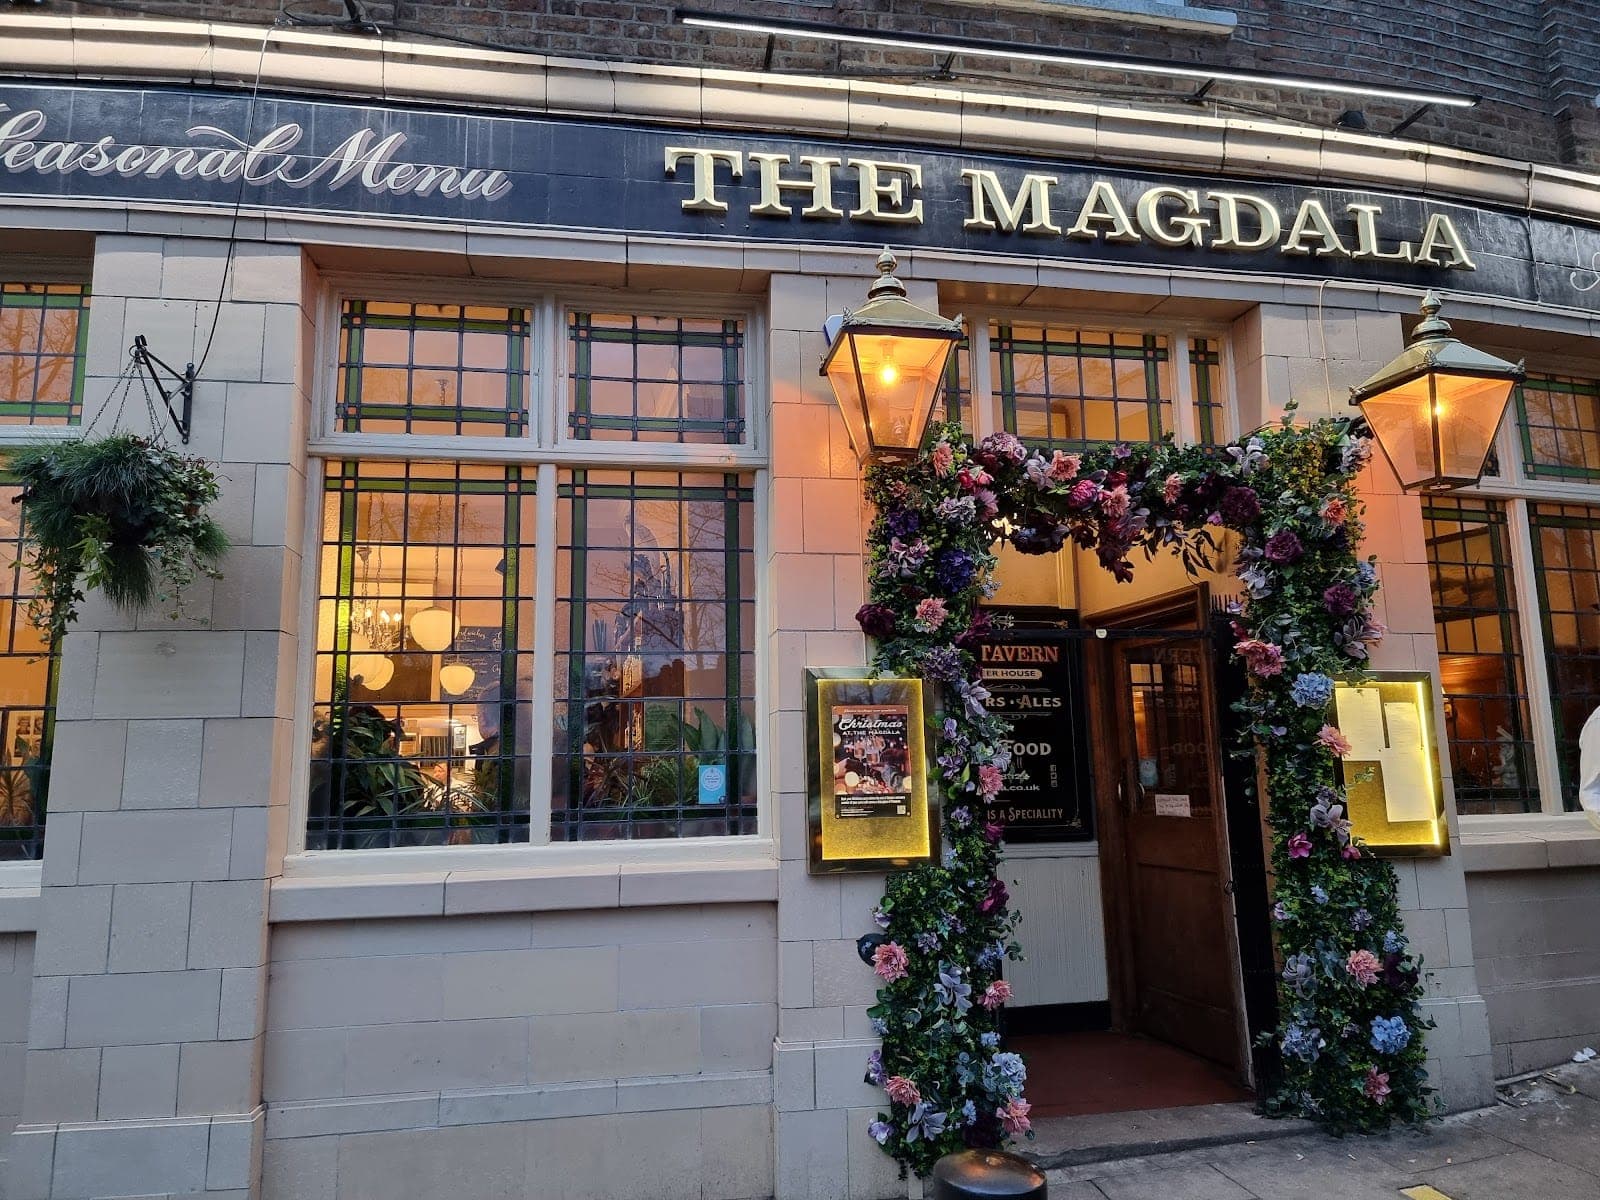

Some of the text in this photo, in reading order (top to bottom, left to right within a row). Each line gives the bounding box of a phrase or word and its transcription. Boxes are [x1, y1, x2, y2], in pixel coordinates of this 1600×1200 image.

[278, 127, 514, 200] Menu
[664, 146, 924, 225] THE
[961, 168, 1477, 271] MAGDALA
[985, 694, 1062, 709] RS ALES
[839, 718, 902, 731] Christmas
[1000, 809, 1006, 819] A
[1008, 806, 1063, 822] SPECIALITY
